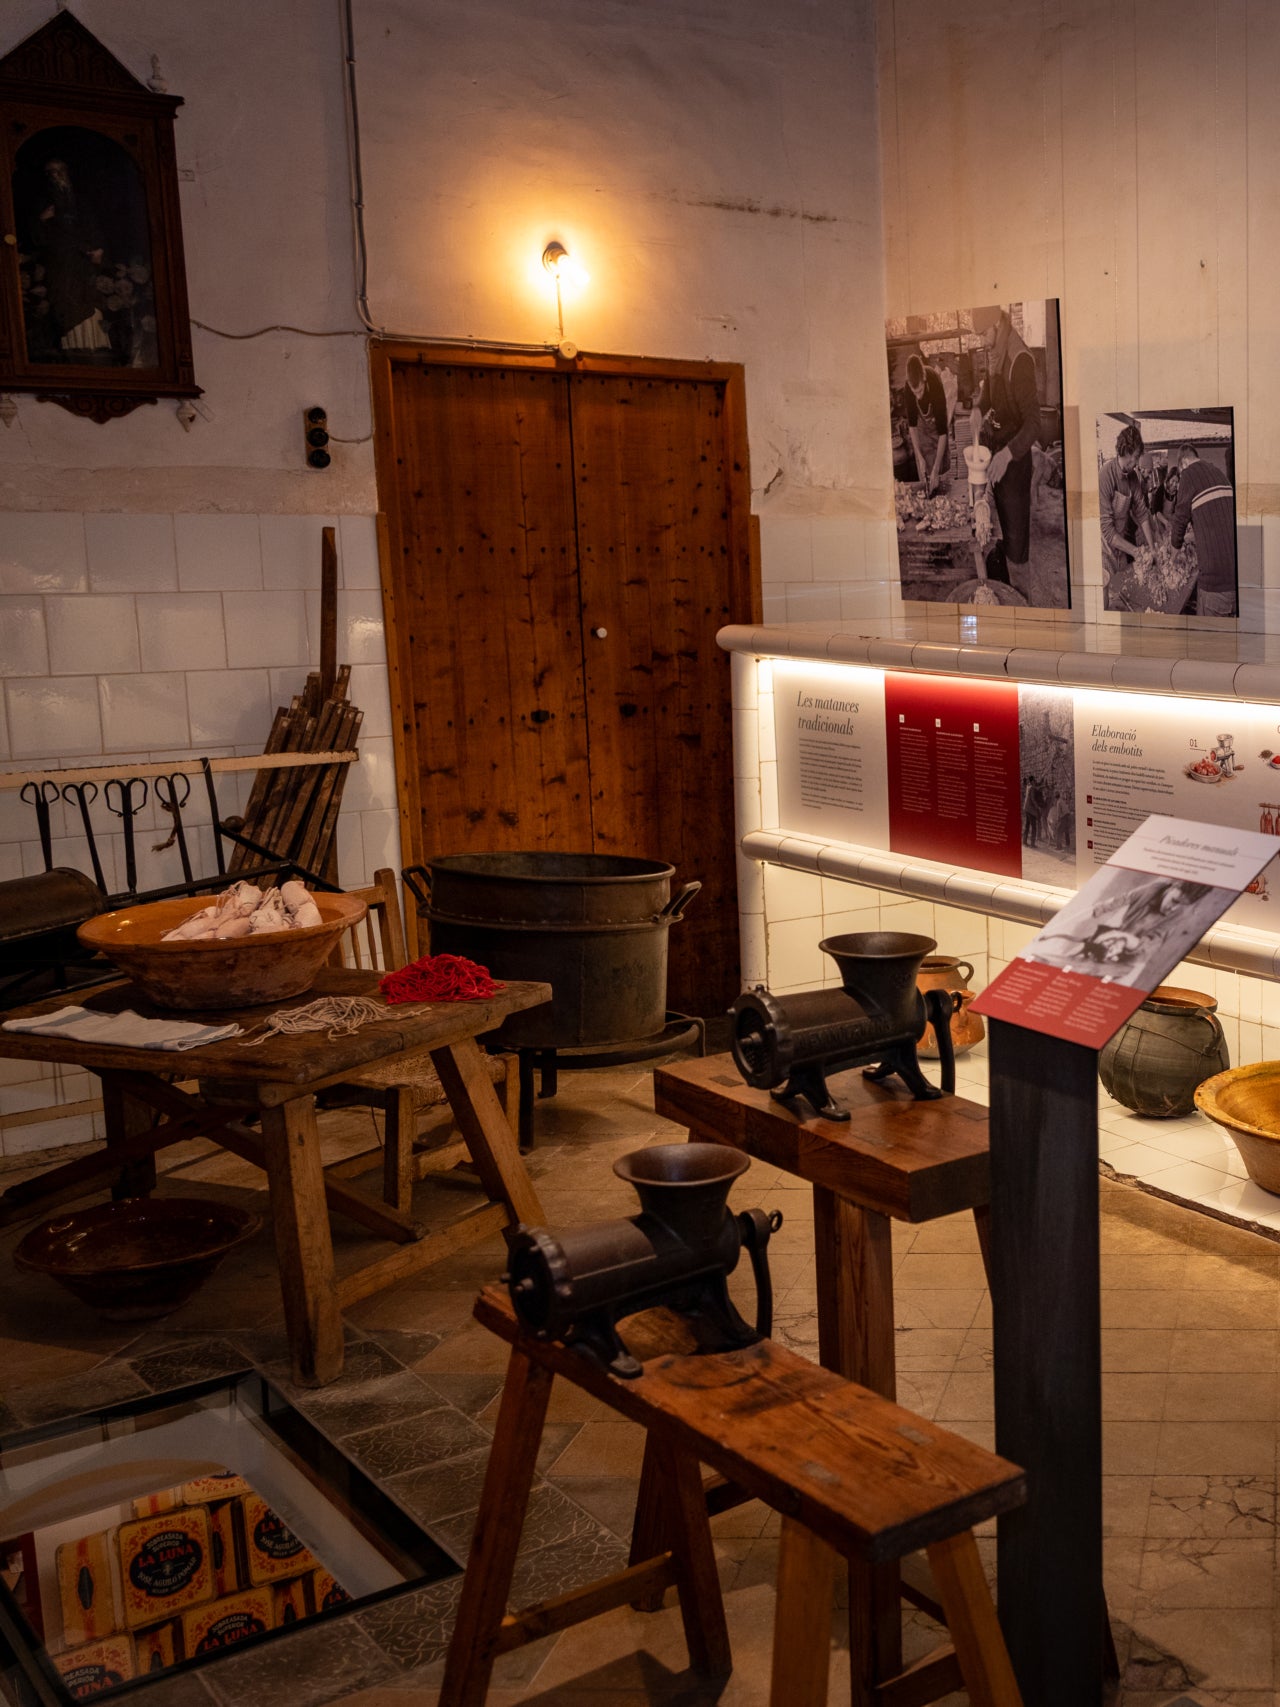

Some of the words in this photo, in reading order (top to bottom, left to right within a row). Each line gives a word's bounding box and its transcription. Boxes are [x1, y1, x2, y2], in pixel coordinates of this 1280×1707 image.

[797, 690, 813, 708] Les
[814, 698, 860, 714] matances
[797, 713, 854, 736] tradicionals
[1091, 724, 1137, 741] Elaboració
[1091, 739, 1108, 753] dels
[1109, 742, 1143, 758] embotits
[1189, 738, 1198, 748] 01
[138, 1554, 155, 1568] LA
[159, 1543, 194, 1562] LUNA
[204, 1637, 220, 1650] LA
[224, 1623, 258, 1646] LUNA
